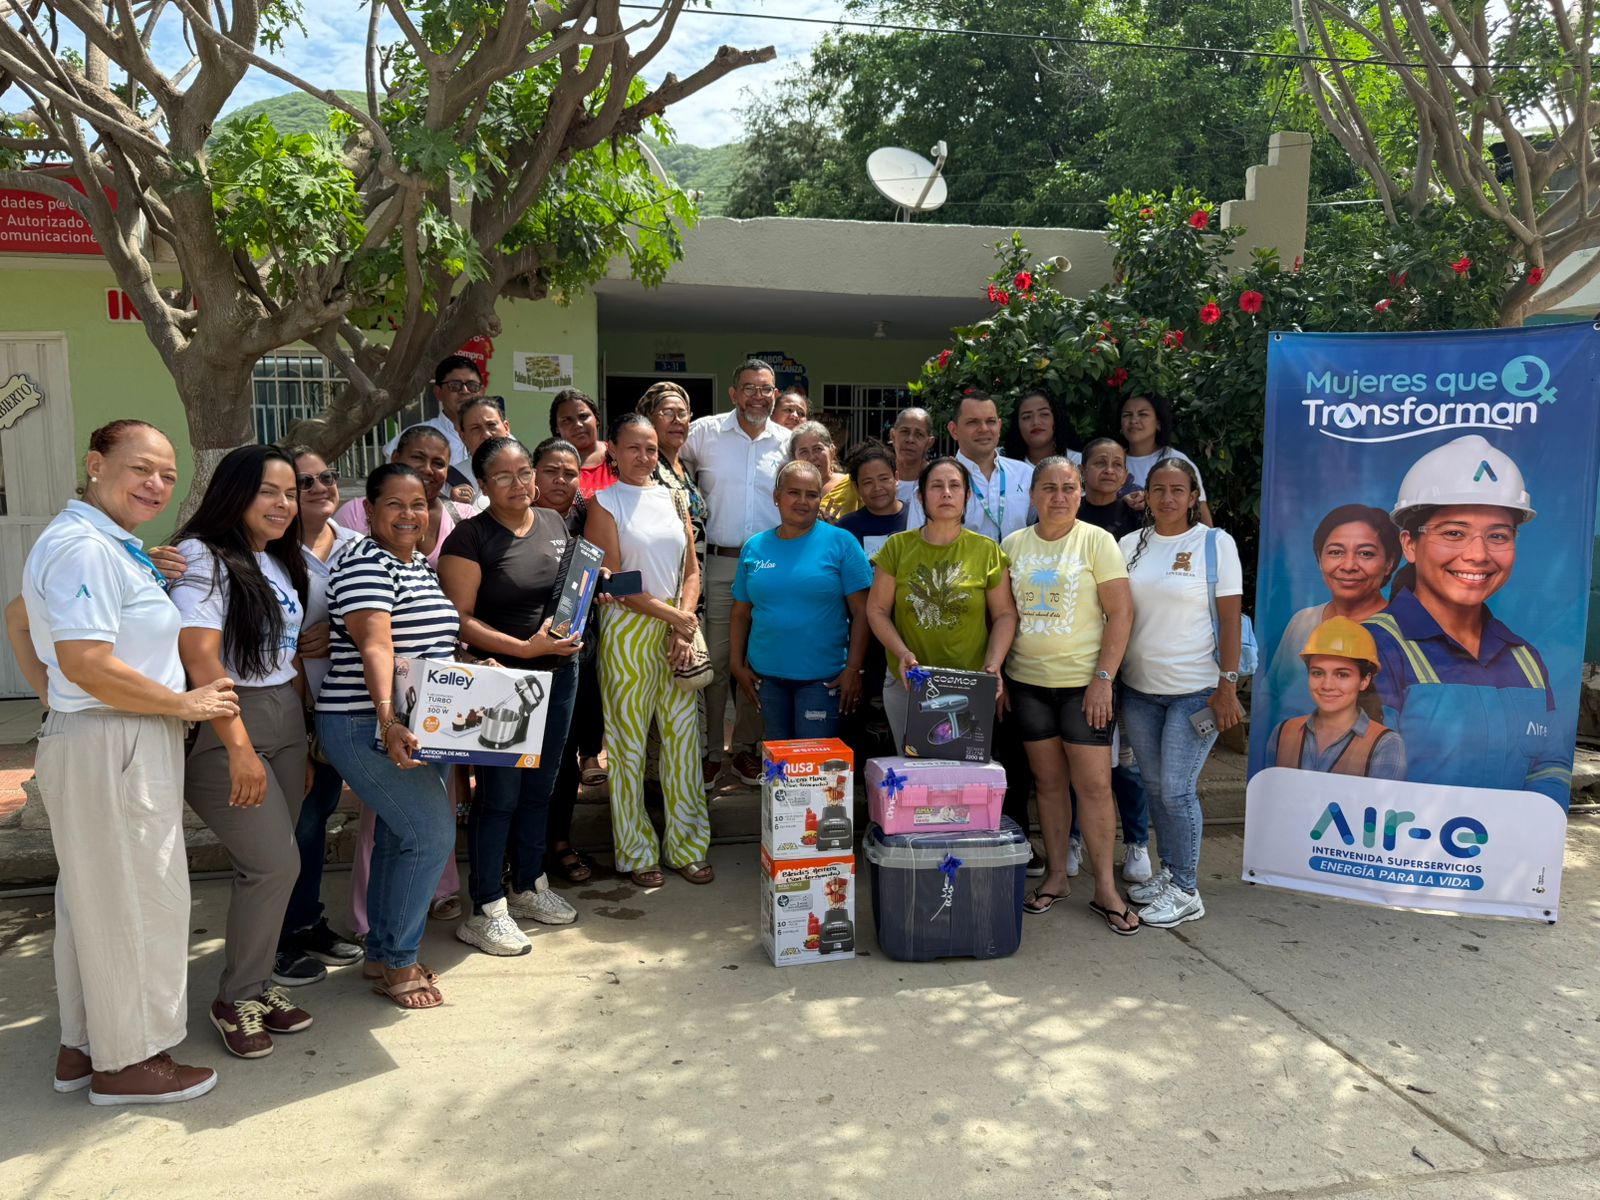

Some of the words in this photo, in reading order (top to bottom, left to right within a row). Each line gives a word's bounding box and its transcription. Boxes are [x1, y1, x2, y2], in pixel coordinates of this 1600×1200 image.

[7, 213, 84, 228] Autorizado
[1306, 370, 1428, 399] Mujeres
[1435, 371, 1497, 397] que
[1301, 397, 1538, 429] Transforman
[1025, 592, 1034, 601] 19
[427, 669, 475, 690] Kalley
[428, 696, 452, 704] TURBO
[1312, 846, 1383, 864] INTERVENIDA
[1387, 857, 1482, 873] SUPERSERVICIOS
[1320, 860, 1375, 878] ENERGÍA
[1379, 870, 1414, 883] PARA
[1418, 874, 1434, 885] LA
[1439, 876, 1471, 888] VIDA
